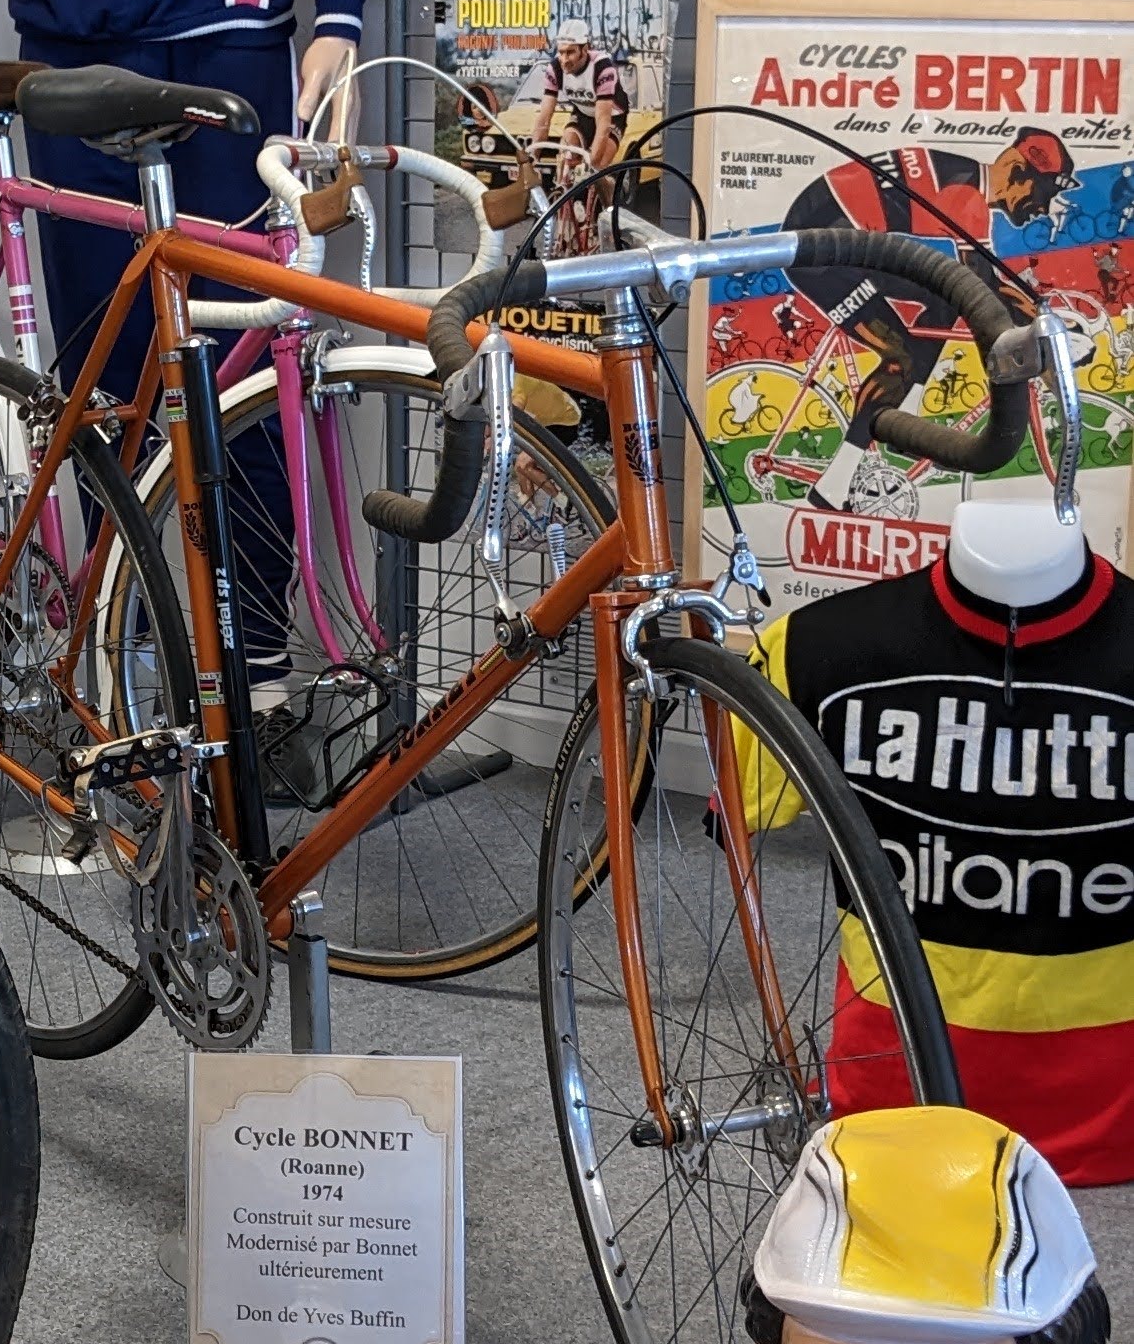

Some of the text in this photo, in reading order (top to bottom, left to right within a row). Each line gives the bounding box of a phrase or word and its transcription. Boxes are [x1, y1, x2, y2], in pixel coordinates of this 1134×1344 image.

[798, 43, 907, 70] CYCLES
[750, 54, 1121, 115] André BERTIN
[833, 112, 1132, 141] dans le monde entier
[731, 152, 816, 166] LAURENT-BLANGY
[720, 178, 758, 190] FRANCE
[751, 167, 783, 178] ARRAS
[828, 278, 878, 325] BERTIN
[216, 599, 235, 650] zéfal
[931, 697, 1134, 802] Hutt
[234, 1126, 413, 1152] Cycle BONNET
[279, 1157, 365, 1180] (Roanne)
[302, 1184, 344, 1202] 1974
[233, 1208, 411, 1231] Construit sur mesure
[226, 1233, 418, 1257] Modernisé par Bonnet
[258, 1261, 385, 1282] ultérieurement
[236, 1304, 406, 1328] Don de Yves Buffin
